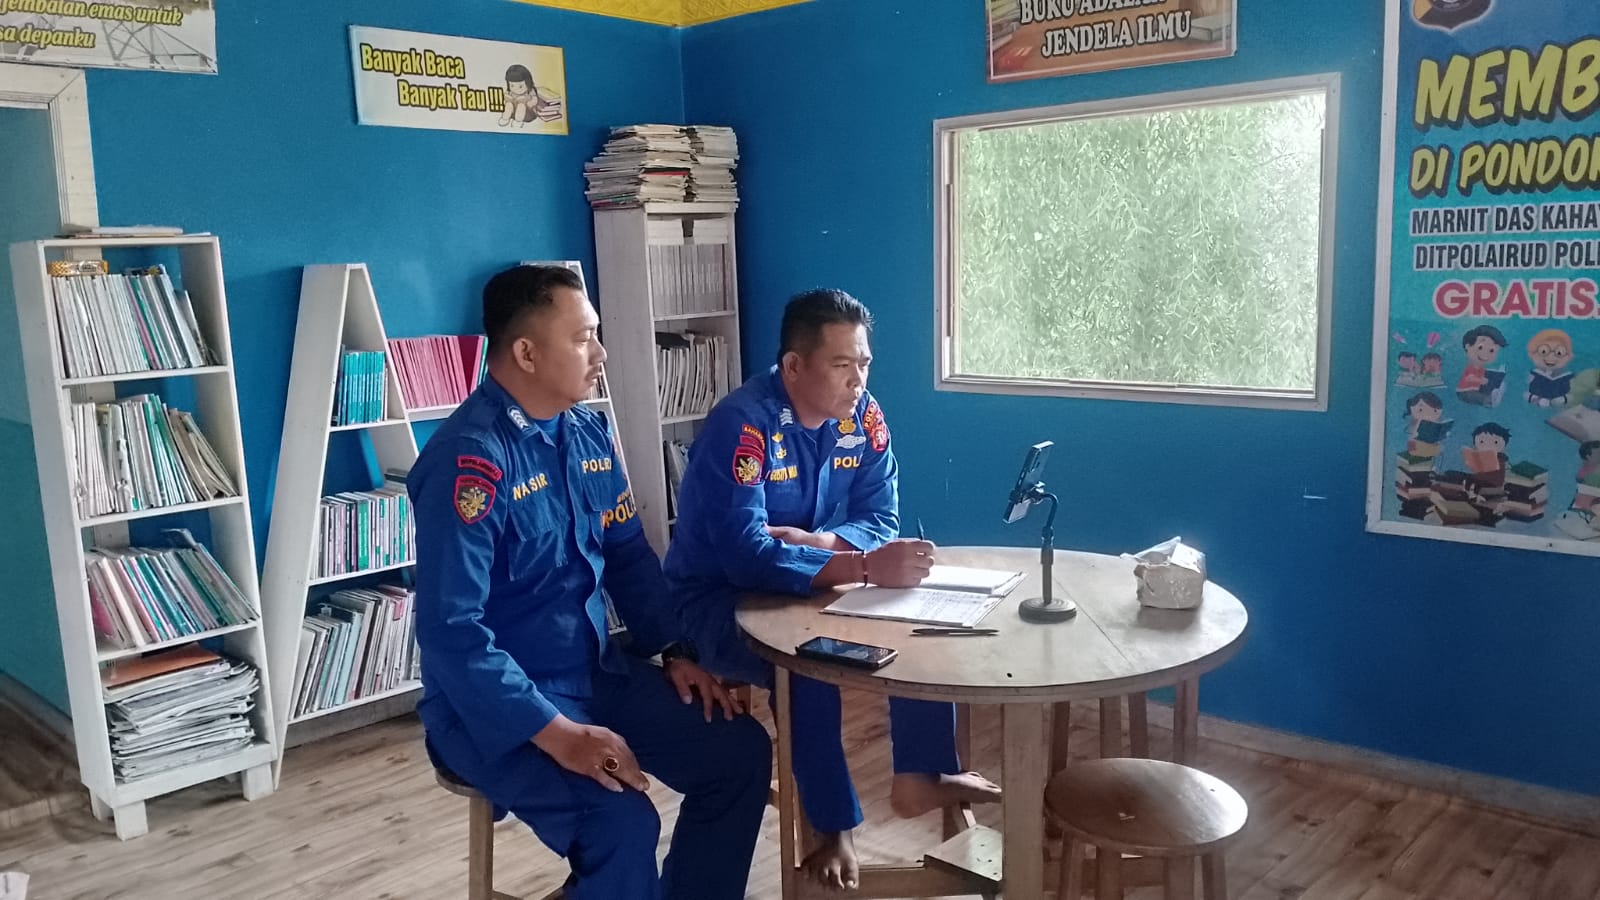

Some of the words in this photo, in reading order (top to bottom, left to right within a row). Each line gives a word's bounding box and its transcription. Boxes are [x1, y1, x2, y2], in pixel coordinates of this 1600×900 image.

[89, 2, 134, 21] emas
[134, 8, 183, 26] untuk
[1020, 0, 1075, 24] BUKU
[1079, 0, 1166, 14] ADA
[20, 24, 95, 48] depanku
[1041, 20, 1134, 57] JENDELA
[1137, 11, 1192, 44] ILMU
[360, 43, 423, 76] Banyak
[424, 50, 465, 78] Baca
[397, 79, 458, 111] Banyak
[459, 84, 485, 112] Tau
[488, 86, 505, 113] !!!
[1414, 36, 1600, 128] MEMB
[1411, 145, 1452, 195] DI
[1411, 208, 1489, 234] MARNIT
[1495, 205, 1535, 231] DAS
[1541, 202, 1600, 230] KAHA
[1415, 243, 1547, 269] DITPOLAIRUD
[1554, 241, 1600, 267] POL
[512, 472, 549, 501] NASIR
